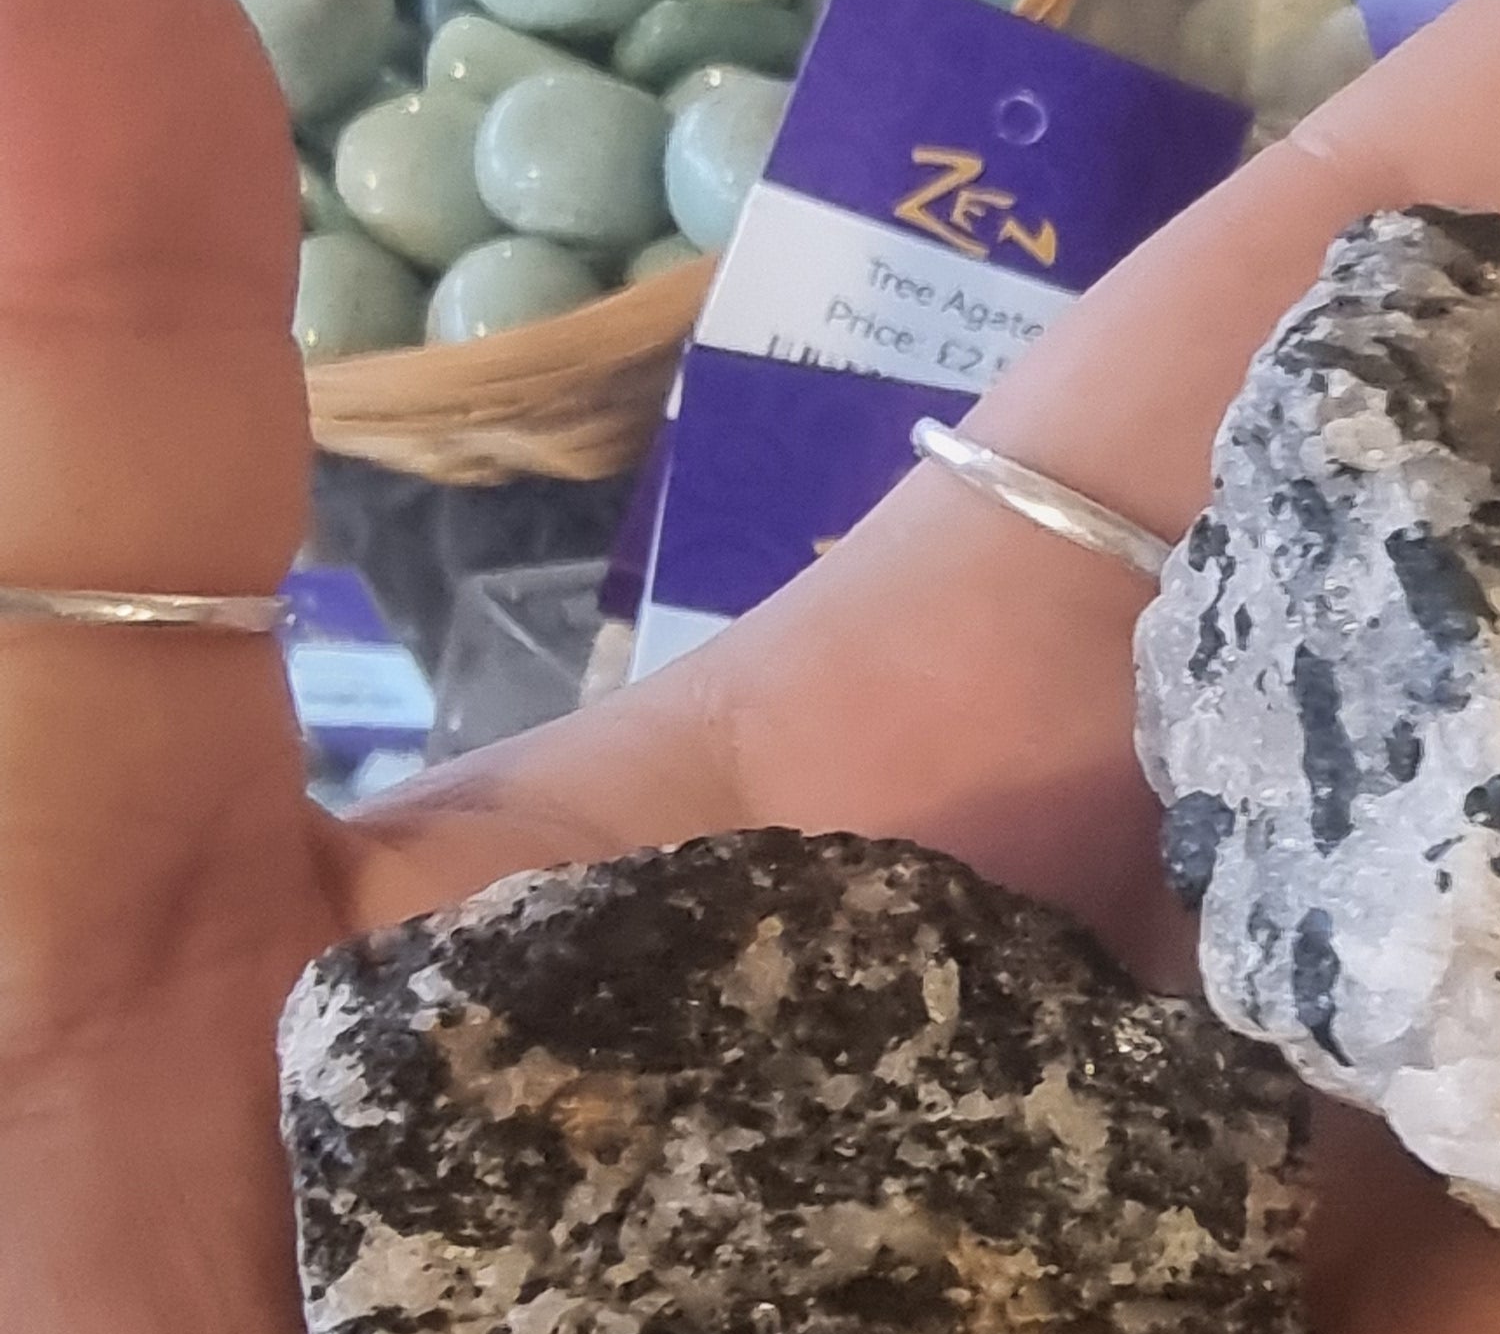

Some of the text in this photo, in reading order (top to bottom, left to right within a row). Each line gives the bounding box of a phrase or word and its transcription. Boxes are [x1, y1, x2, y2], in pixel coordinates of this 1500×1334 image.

[894, 145, 1057, 267] ZEN
[869, 257, 1046, 342] Tree Agate
